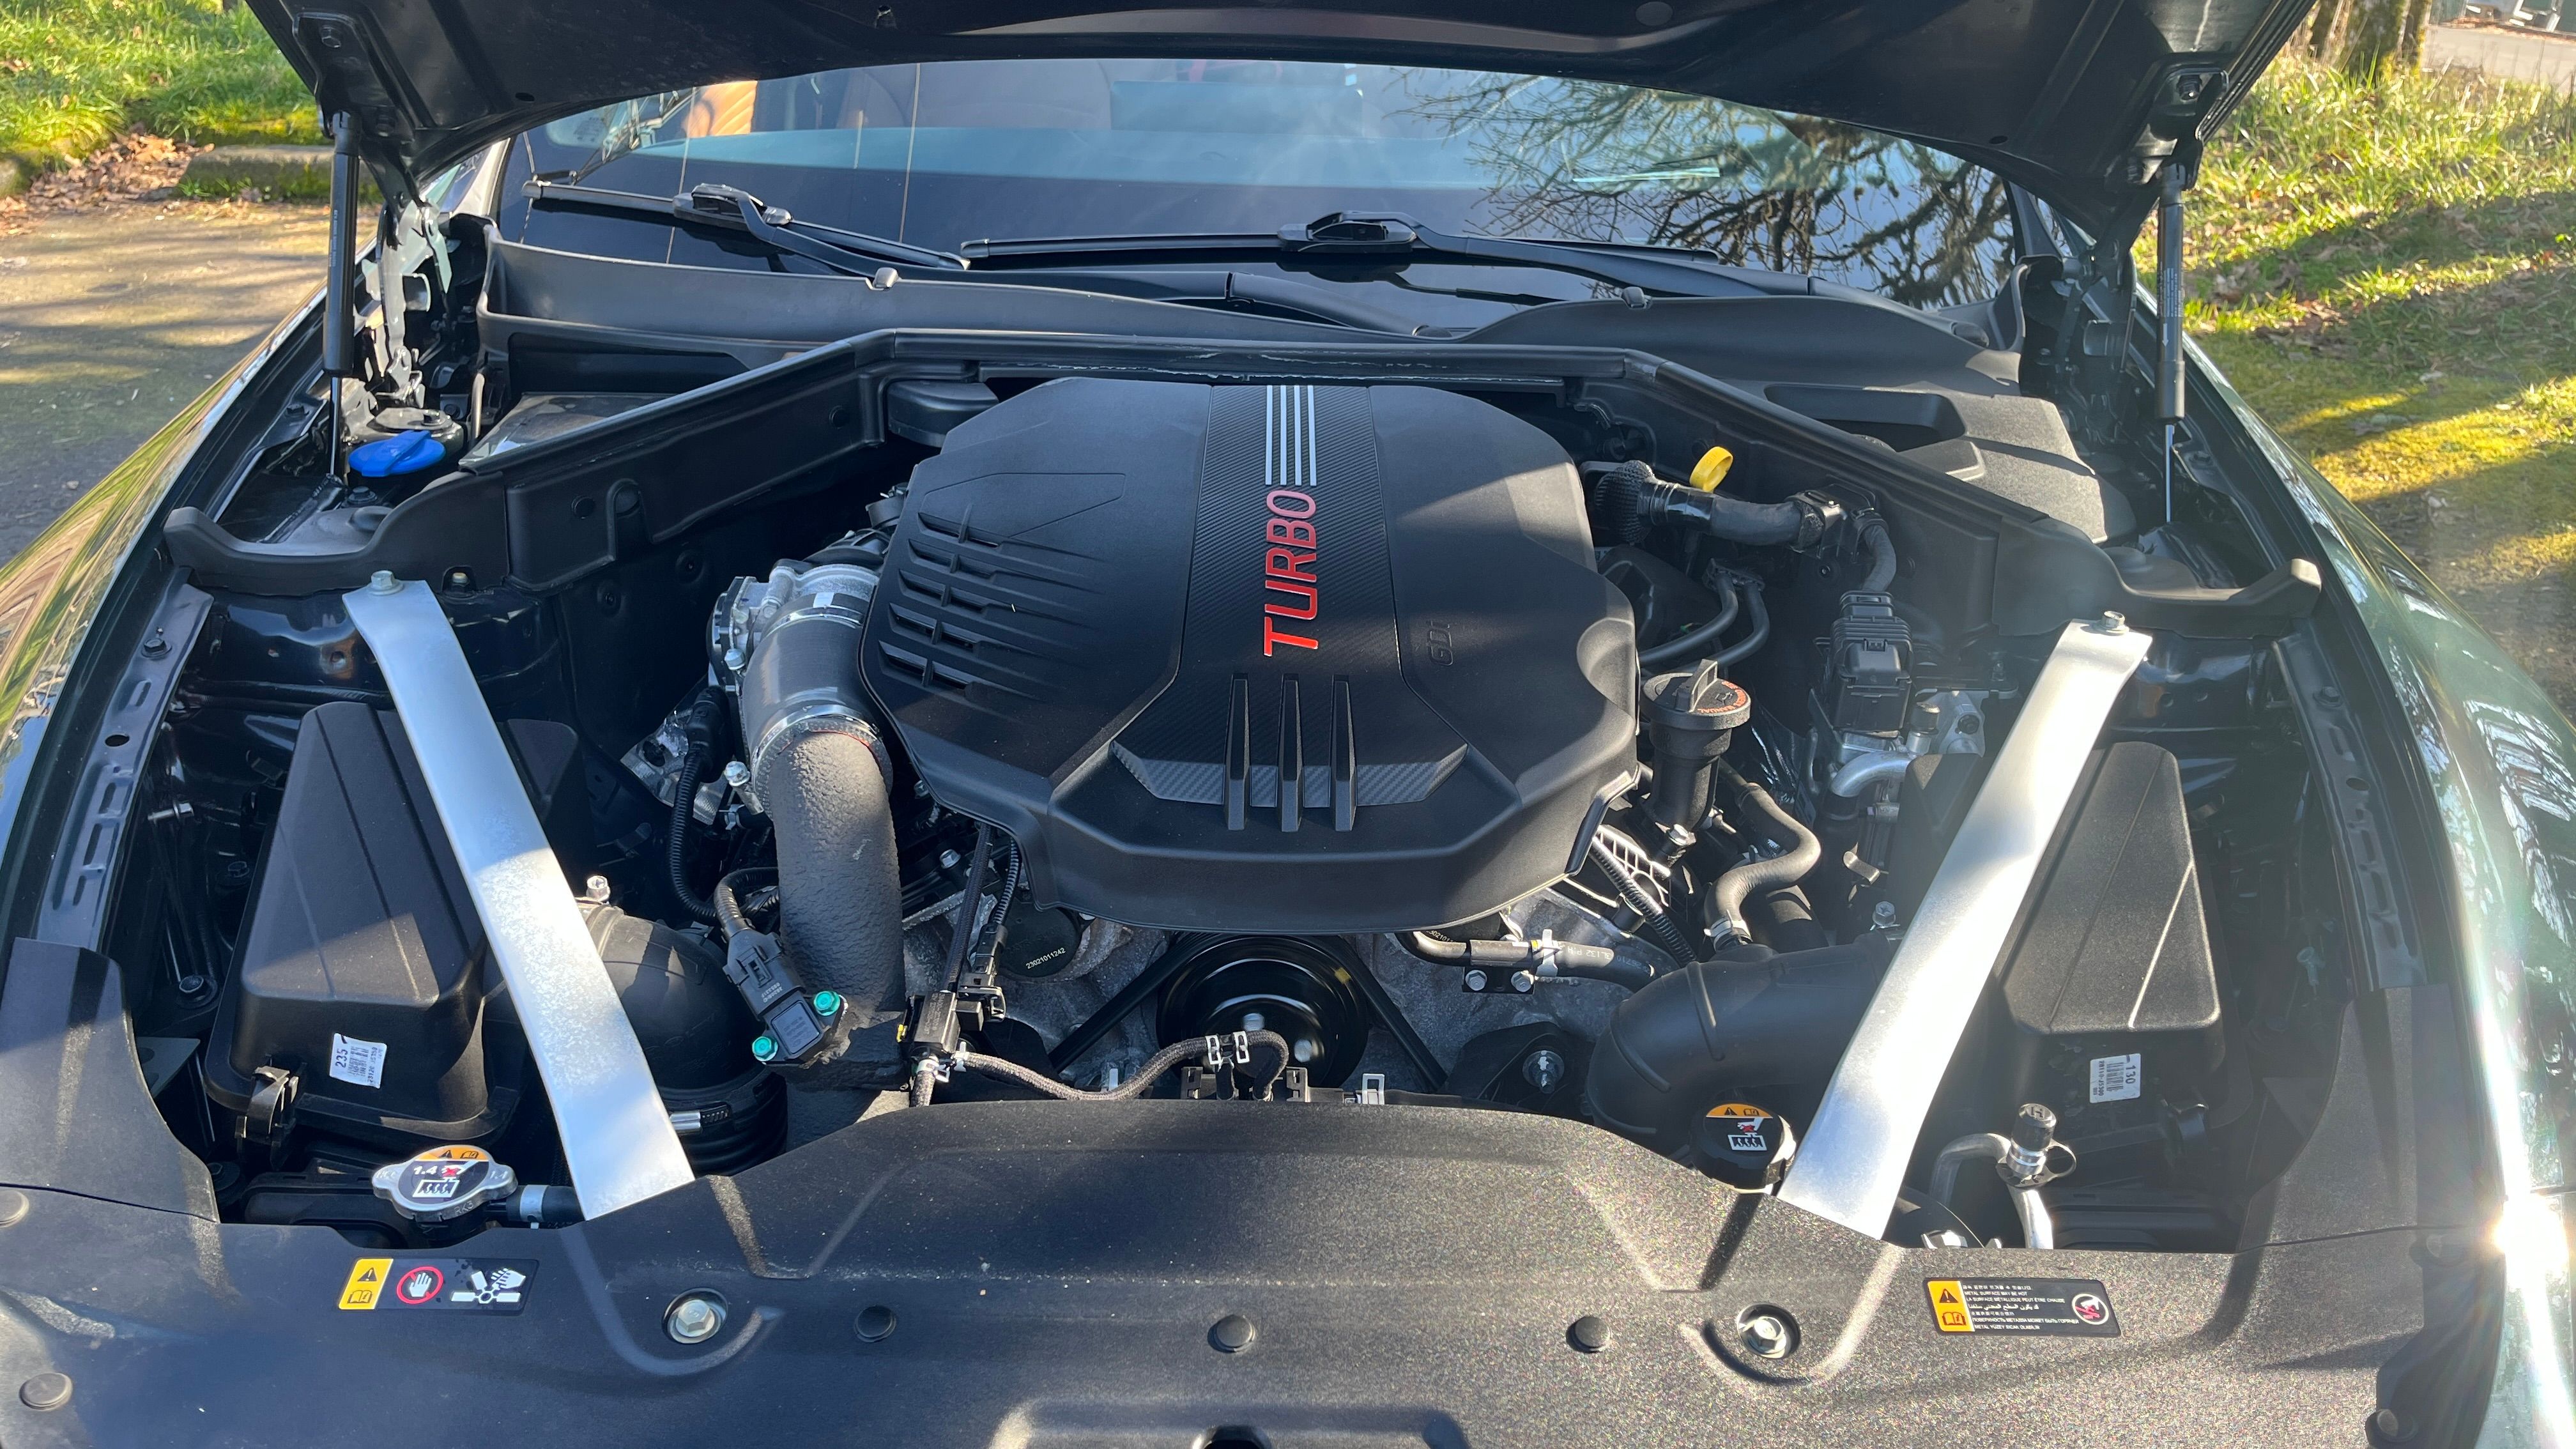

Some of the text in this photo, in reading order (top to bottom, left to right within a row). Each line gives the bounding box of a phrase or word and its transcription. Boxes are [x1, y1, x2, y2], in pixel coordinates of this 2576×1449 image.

[1264, 490, 1319, 657] TURBO
[1025, 947, 1066, 969] 23021011242
[335, 1048, 348, 1068] 235
[2126, 1065, 2136, 1084] 130
[413, 1165, 438, 1175] 1.4
[454, 1200, 475, 1215] RK3
